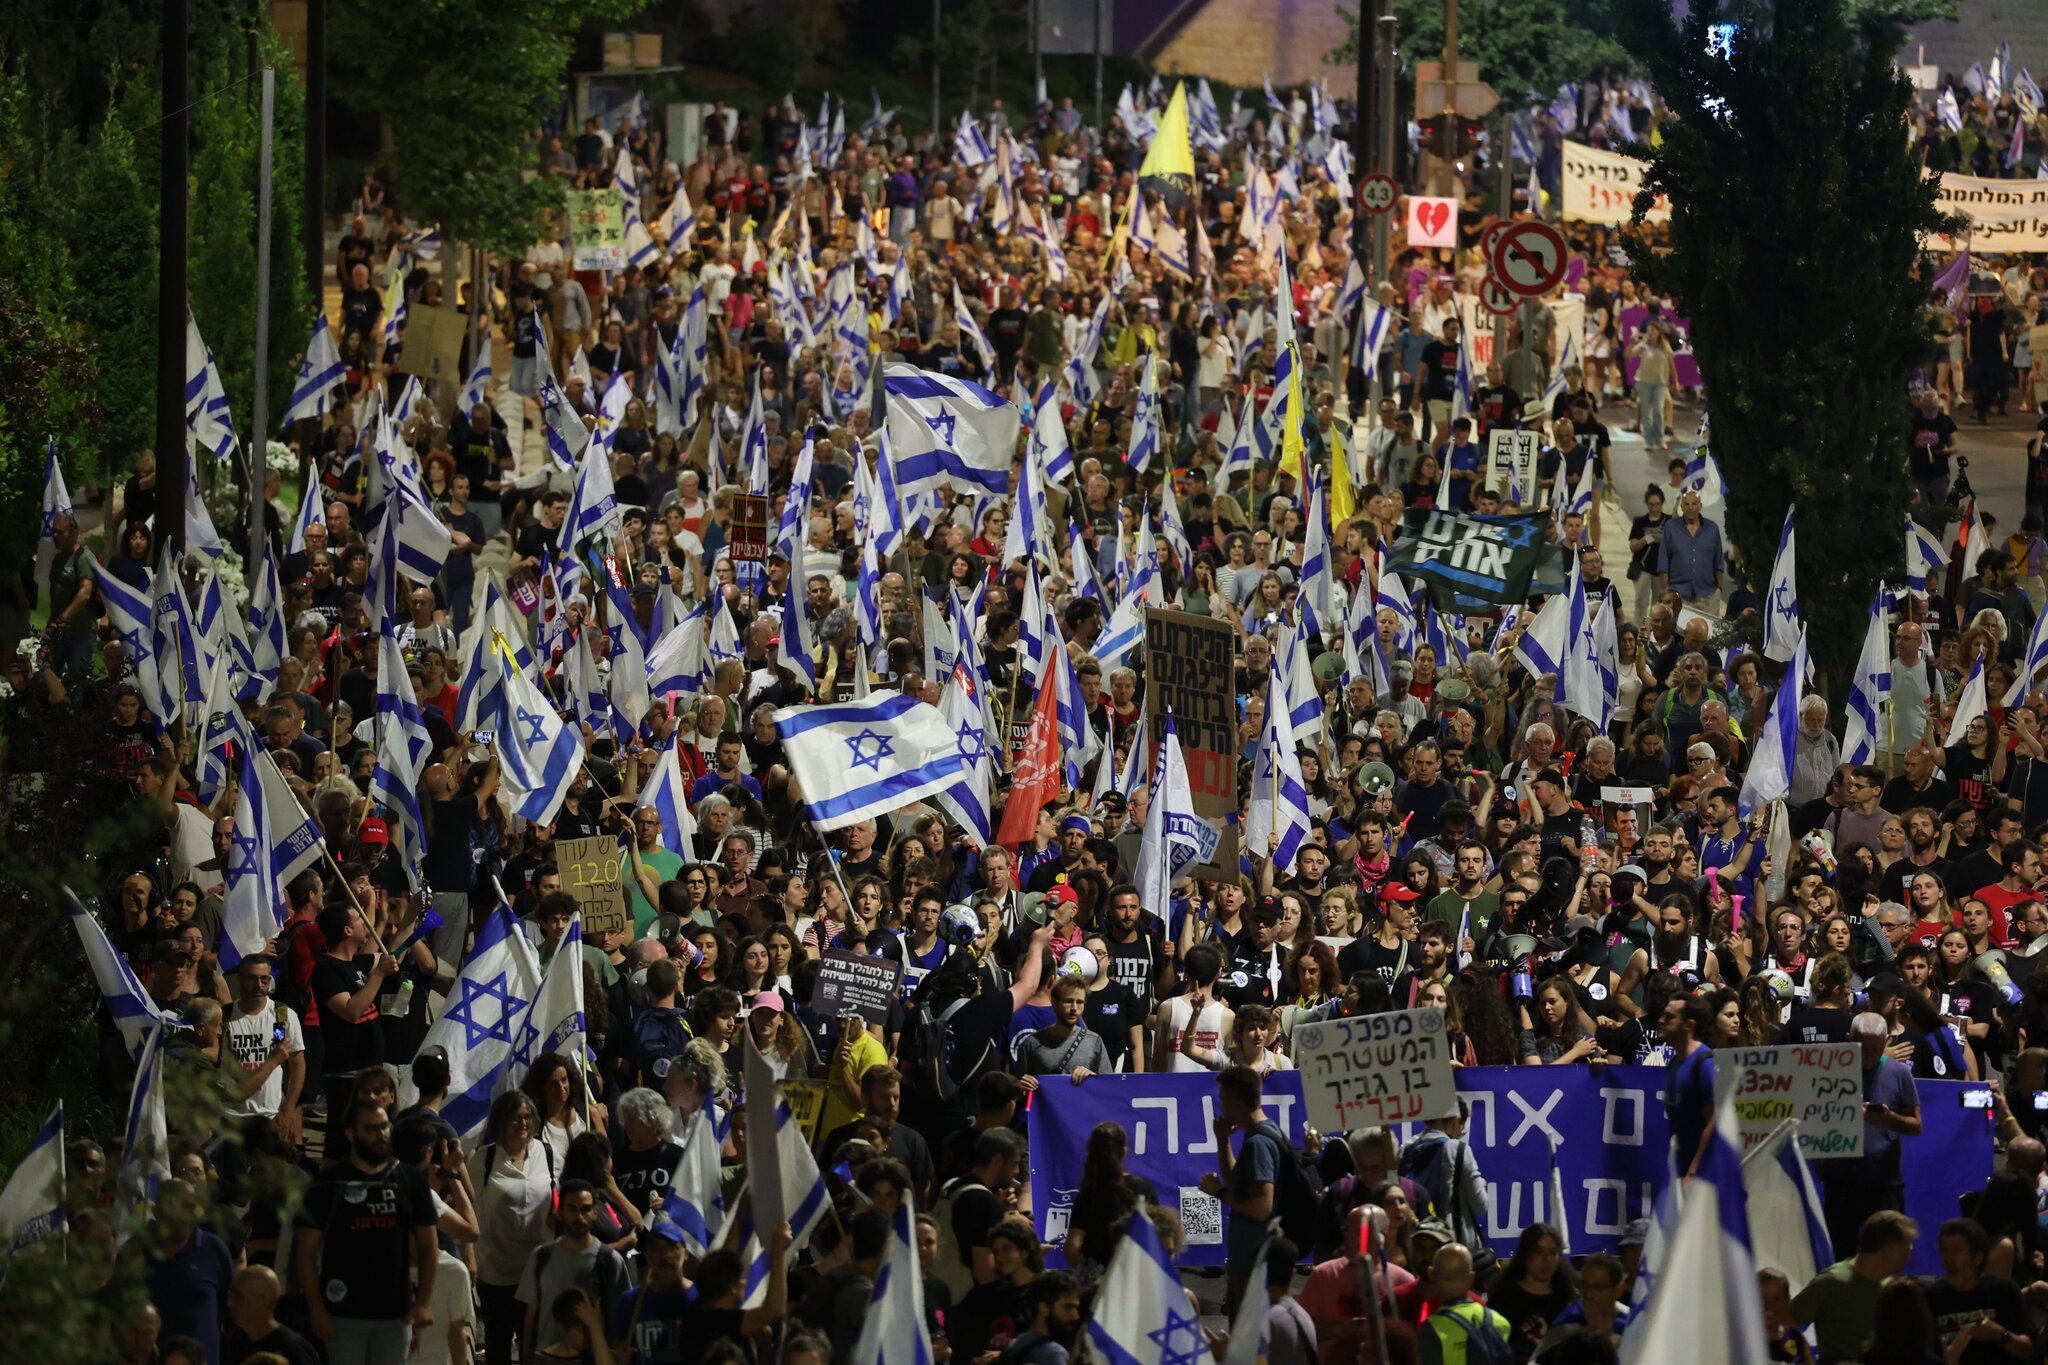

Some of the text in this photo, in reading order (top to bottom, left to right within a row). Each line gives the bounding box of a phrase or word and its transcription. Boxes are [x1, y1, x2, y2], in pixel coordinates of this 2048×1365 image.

[1367, 187, 1389, 202] 4.3
[598, 836, 615, 855] יש
[570, 859, 619, 886] 120
[233, 1033, 263, 1048] אתה
[1335, 1094, 1423, 1129] עבריין
